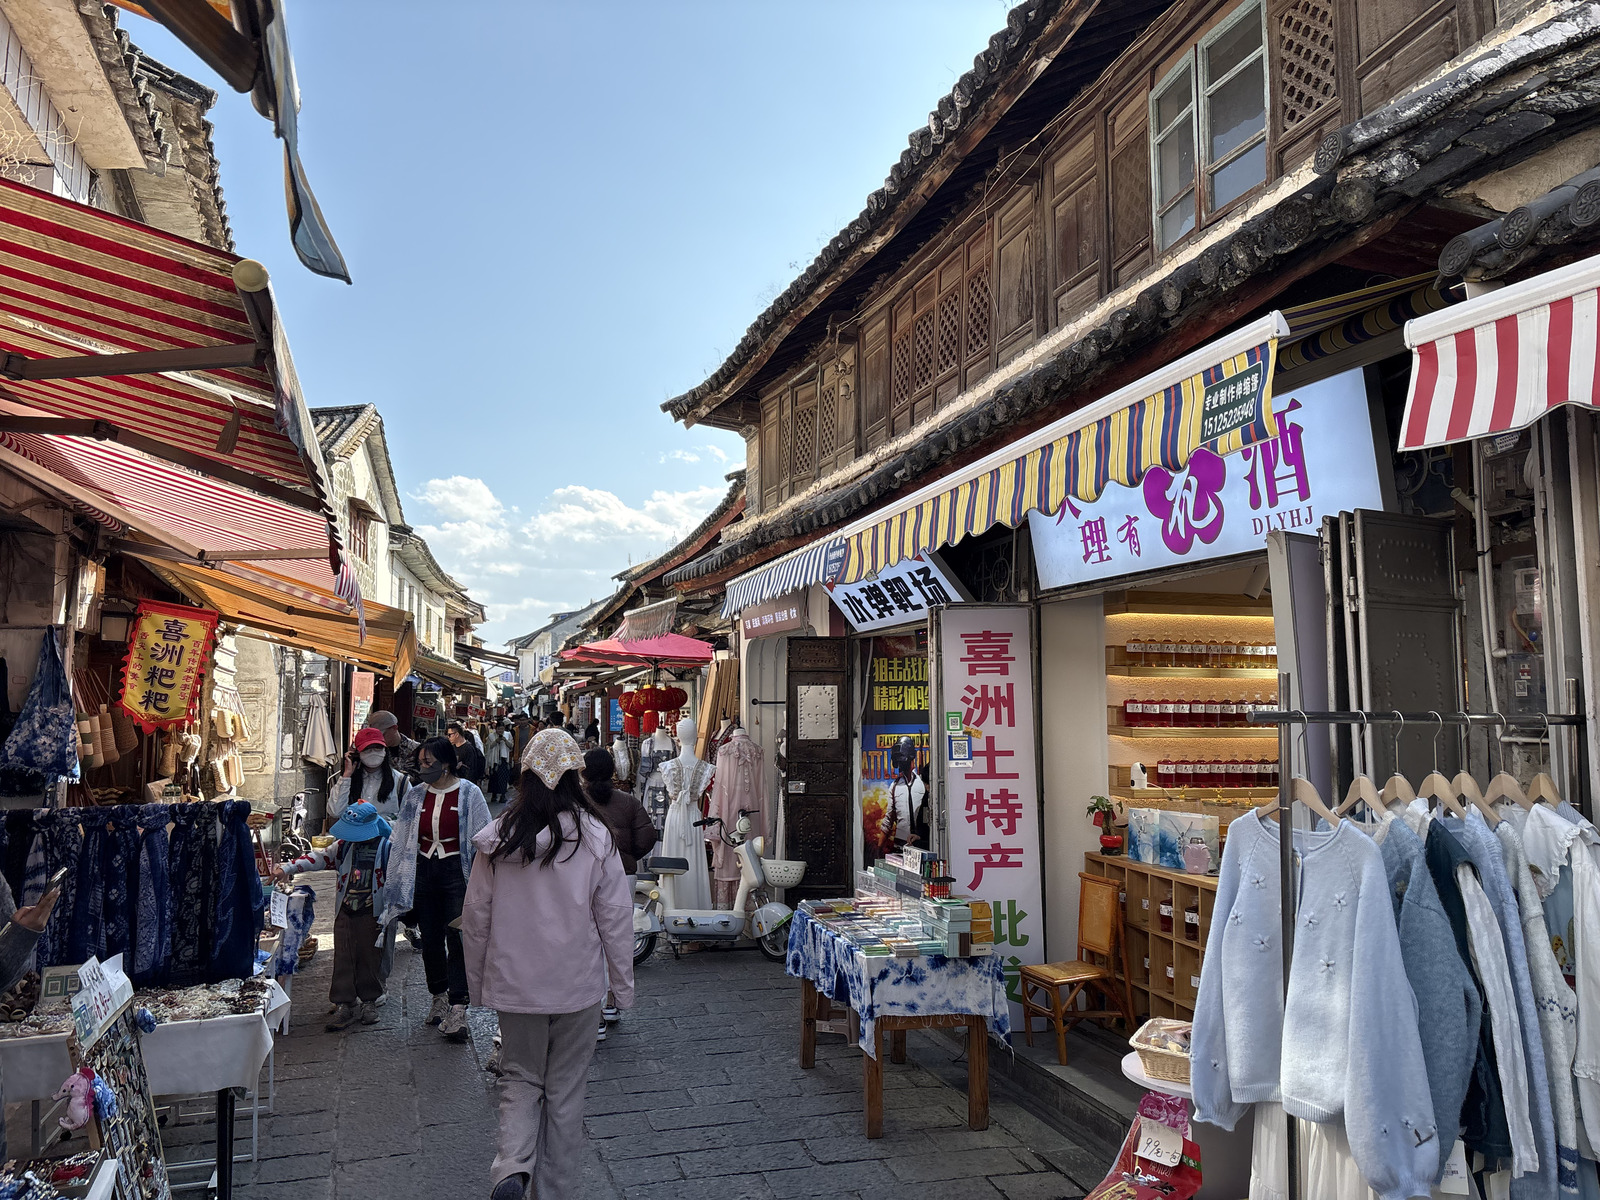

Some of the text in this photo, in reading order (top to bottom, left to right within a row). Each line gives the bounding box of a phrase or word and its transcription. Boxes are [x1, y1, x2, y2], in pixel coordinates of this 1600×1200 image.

[1251, 506, 1314, 535] DLYHJ
[842, 566, 952, 624] 水弹靶场
[139, 619, 190, 713] 喜洲粑粑
